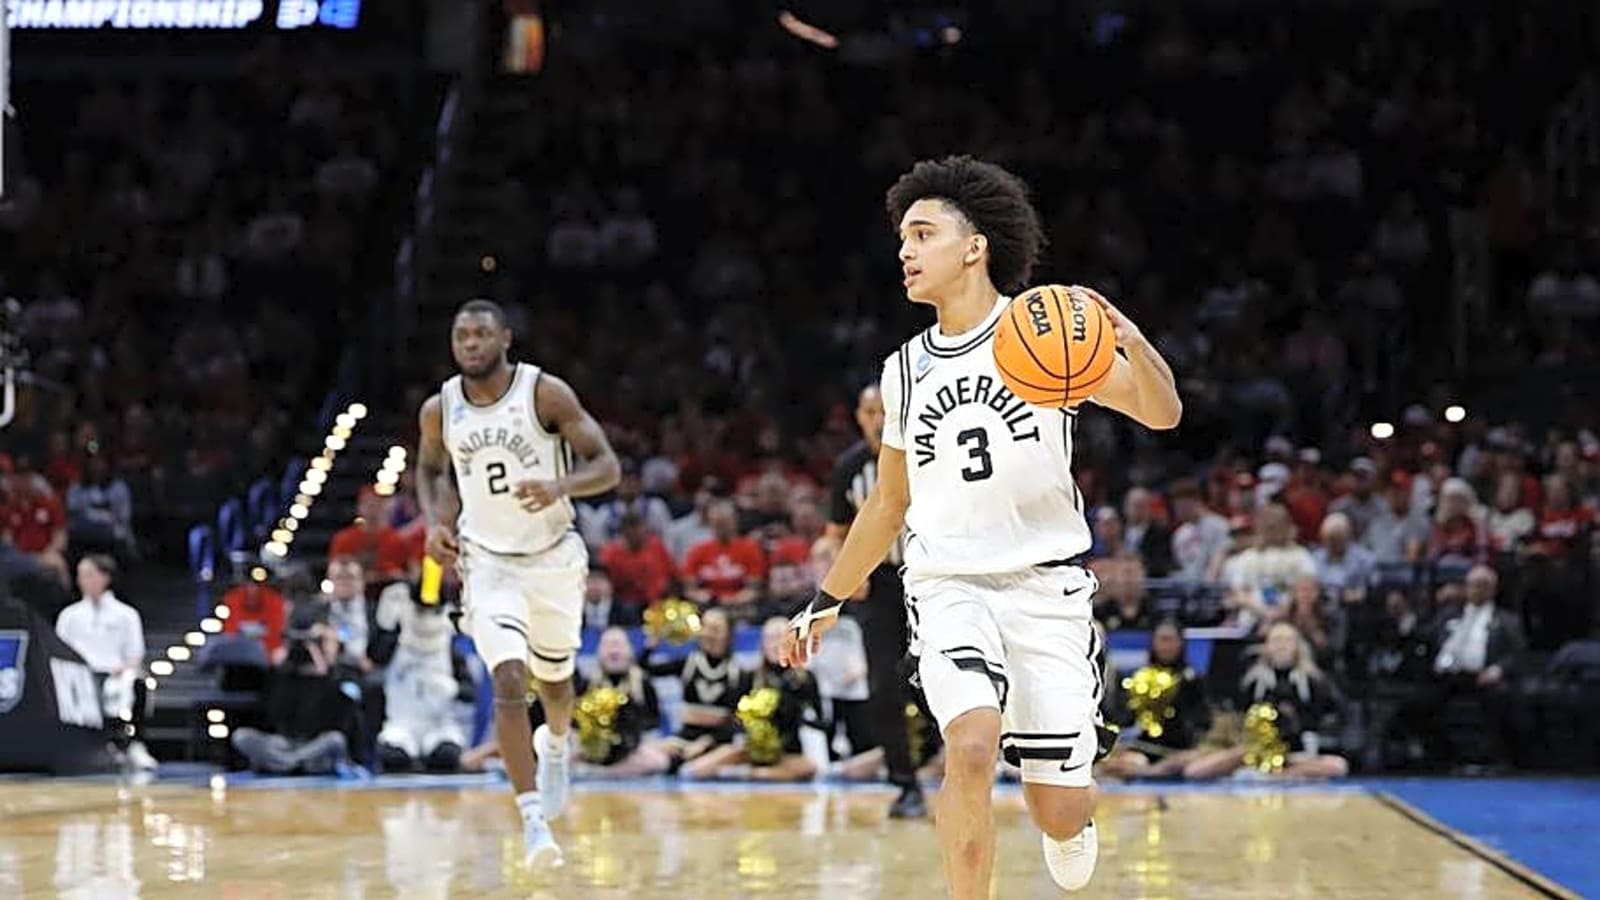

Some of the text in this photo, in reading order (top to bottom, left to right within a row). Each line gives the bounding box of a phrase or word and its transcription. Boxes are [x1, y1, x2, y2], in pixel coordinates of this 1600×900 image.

[1026, 291, 1052, 336] NCAA
[914, 375, 1040, 467] VANDERBILT
[486, 462, 509, 494] 2
[957, 426, 993, 482] 3
